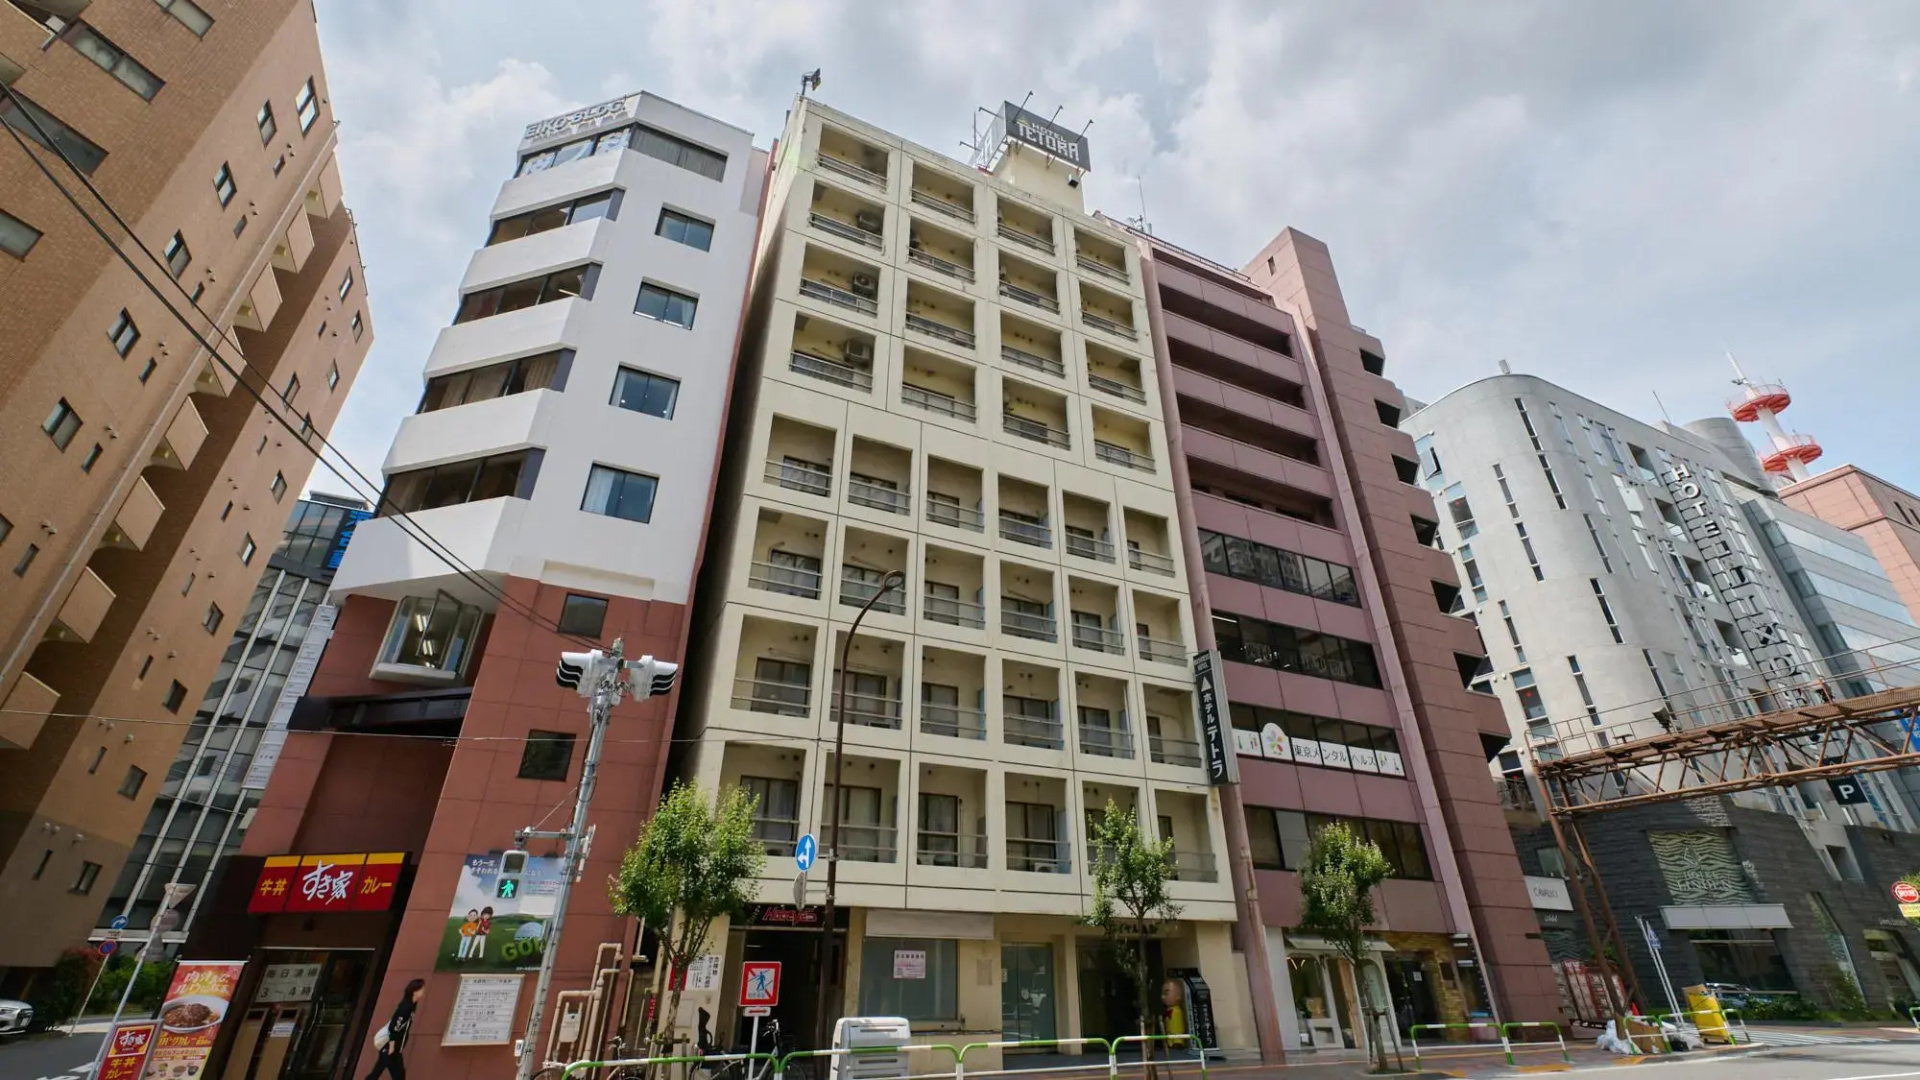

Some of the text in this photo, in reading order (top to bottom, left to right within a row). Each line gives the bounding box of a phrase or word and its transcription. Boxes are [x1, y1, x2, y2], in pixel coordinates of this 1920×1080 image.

[1016, 121, 1080, 162] TETORA
[1032, 122, 1068, 143] HOTEL
[1202, 692, 1223, 778] ホテルテトラ
[1293, 743, 1377, 767] 東京メンタルヘルス
[1838, 784, 1855, 800] P
[260, 860, 392, 906] 牛丼 すき家 カレー
[110, 1057, 135, 1068] 牛丼
[106, 1070, 133, 1079] カレー
